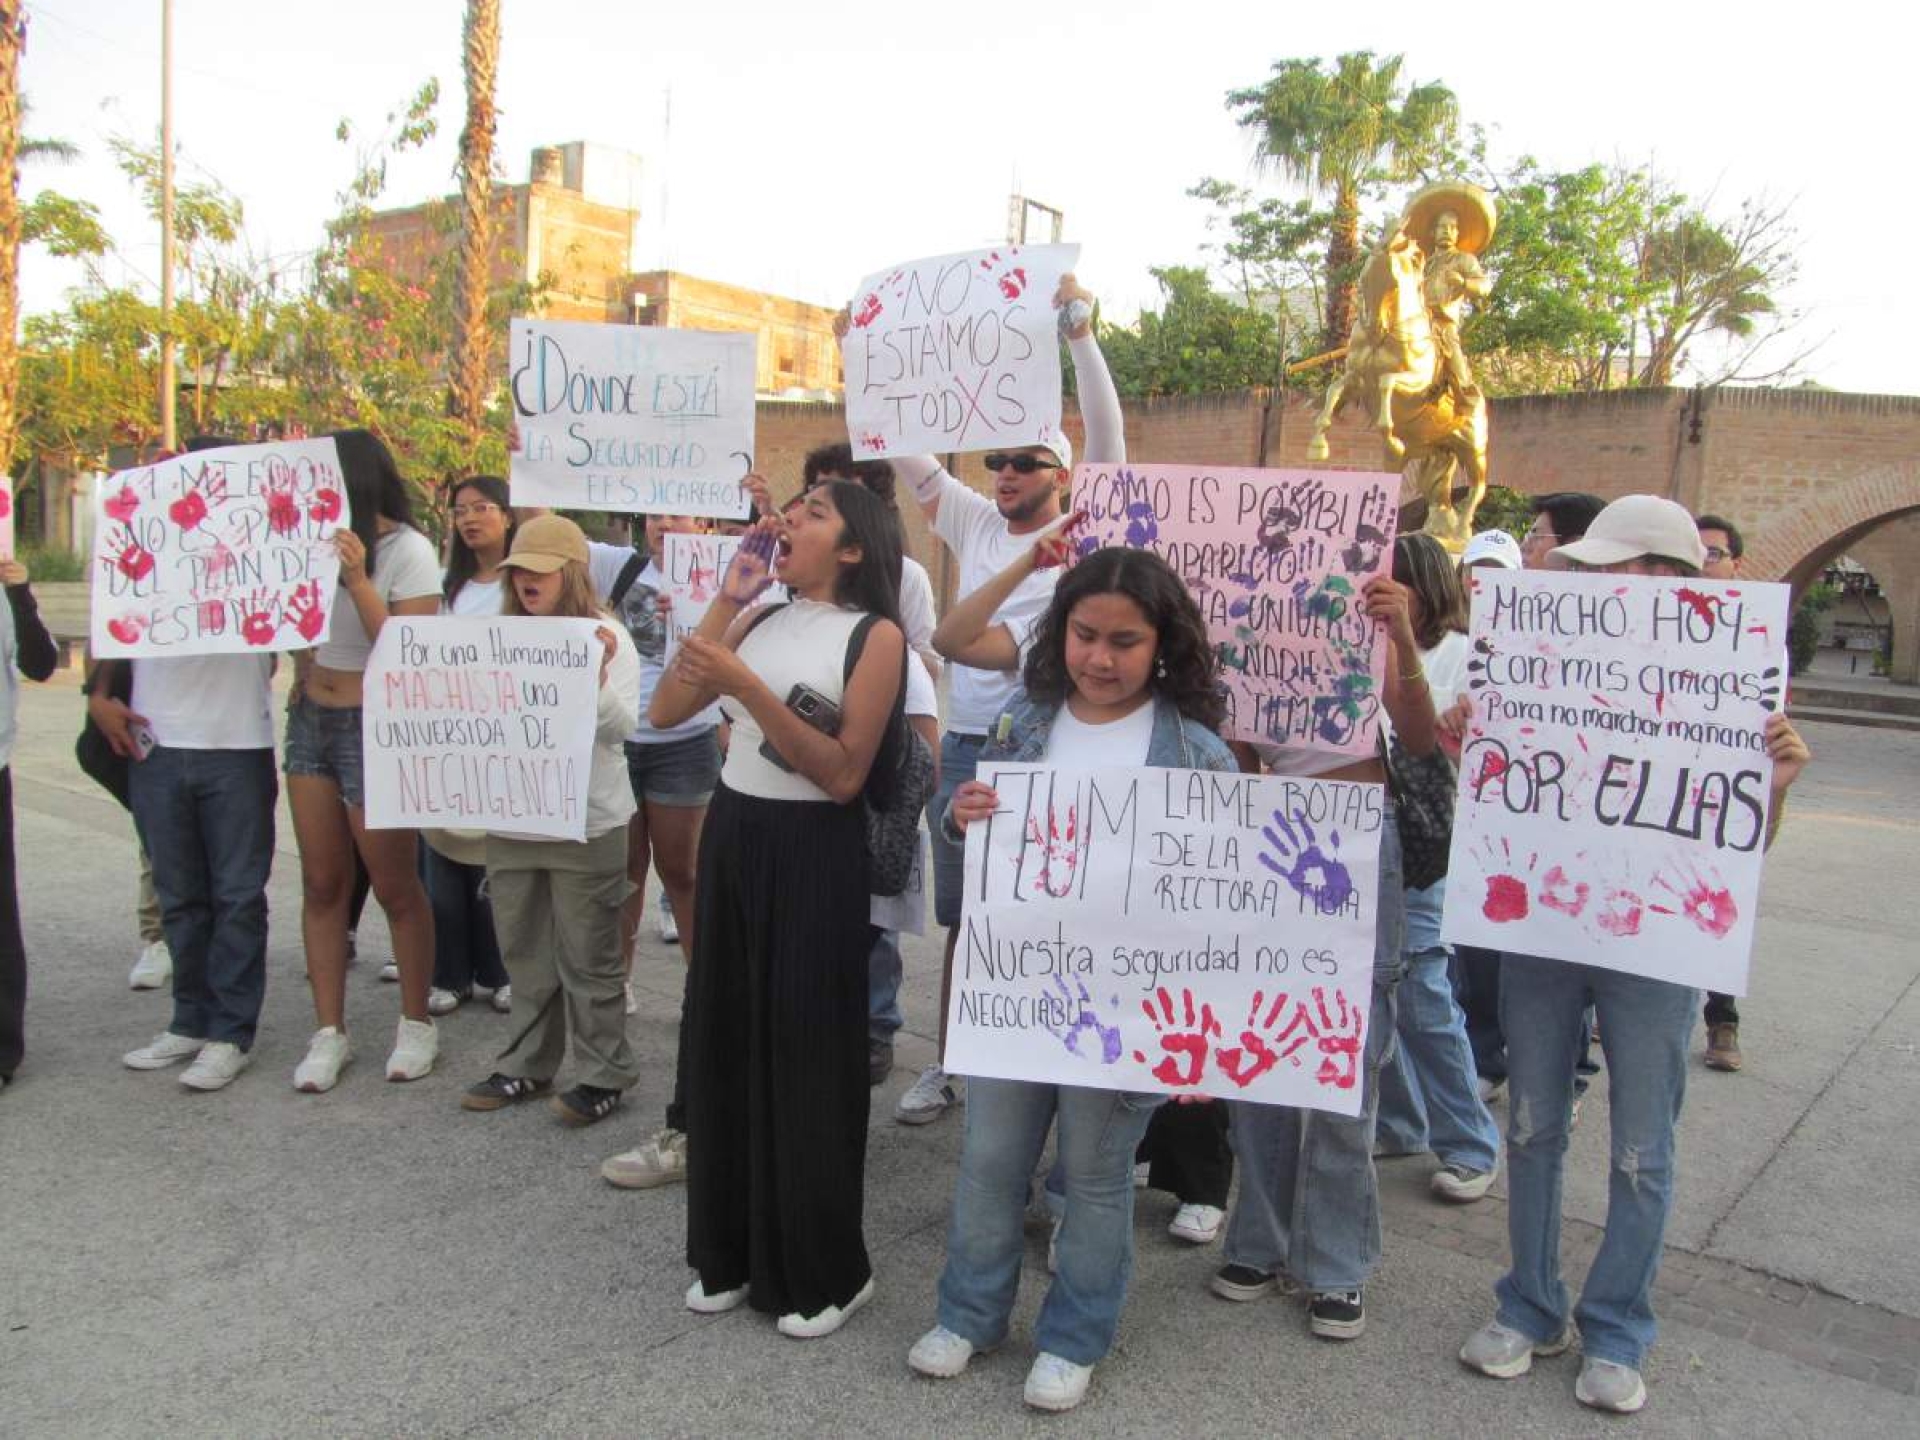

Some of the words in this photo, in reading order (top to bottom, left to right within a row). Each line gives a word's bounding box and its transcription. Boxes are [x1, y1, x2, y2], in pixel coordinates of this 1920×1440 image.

[902, 258, 972, 320] NO
[863, 305, 1033, 395] ESTAMOS
[883, 370, 1026, 445] TODXS
[526, 430, 554, 462] LA
[567, 422, 706, 468] SEGURIDAD
[1188, 476, 1220, 524] ES
[125, 516, 166, 552] NO
[1492, 584, 1627, 638] MARCHO
[1653, 594, 1743, 652] HOY
[401, 625, 429, 667] Por
[441, 643, 478, 666] una
[489, 626, 589, 668] Humanidad
[523, 680, 559, 707] una
[1561, 656, 1629, 692] mis
[375, 717, 506, 748] UNIVERSIDA
[520, 714, 556, 750] DE
[1480, 690, 1543, 722] Para
[1550, 702, 1578, 726] no
[1582, 706, 1662, 738] marchar
[398, 753, 577, 821] NEGLIGENCIA
[1164, 771, 1262, 829] LAME
[1282, 780, 1382, 833] BOTAS
[1466, 737, 1571, 822] POR
[1594, 753, 1766, 853] ELLAS
[1150, 831, 1196, 868] DE
[1206, 832, 1240, 873] LA
[1154, 873, 1279, 918] RECTORA
[965, 916, 1094, 981] Nuestra
[1112, 934, 1240, 991] seguridad
[1255, 945, 1290, 974] no
[1302, 948, 1339, 975] es
[958, 989, 1094, 1029] NEGOCIABLE
